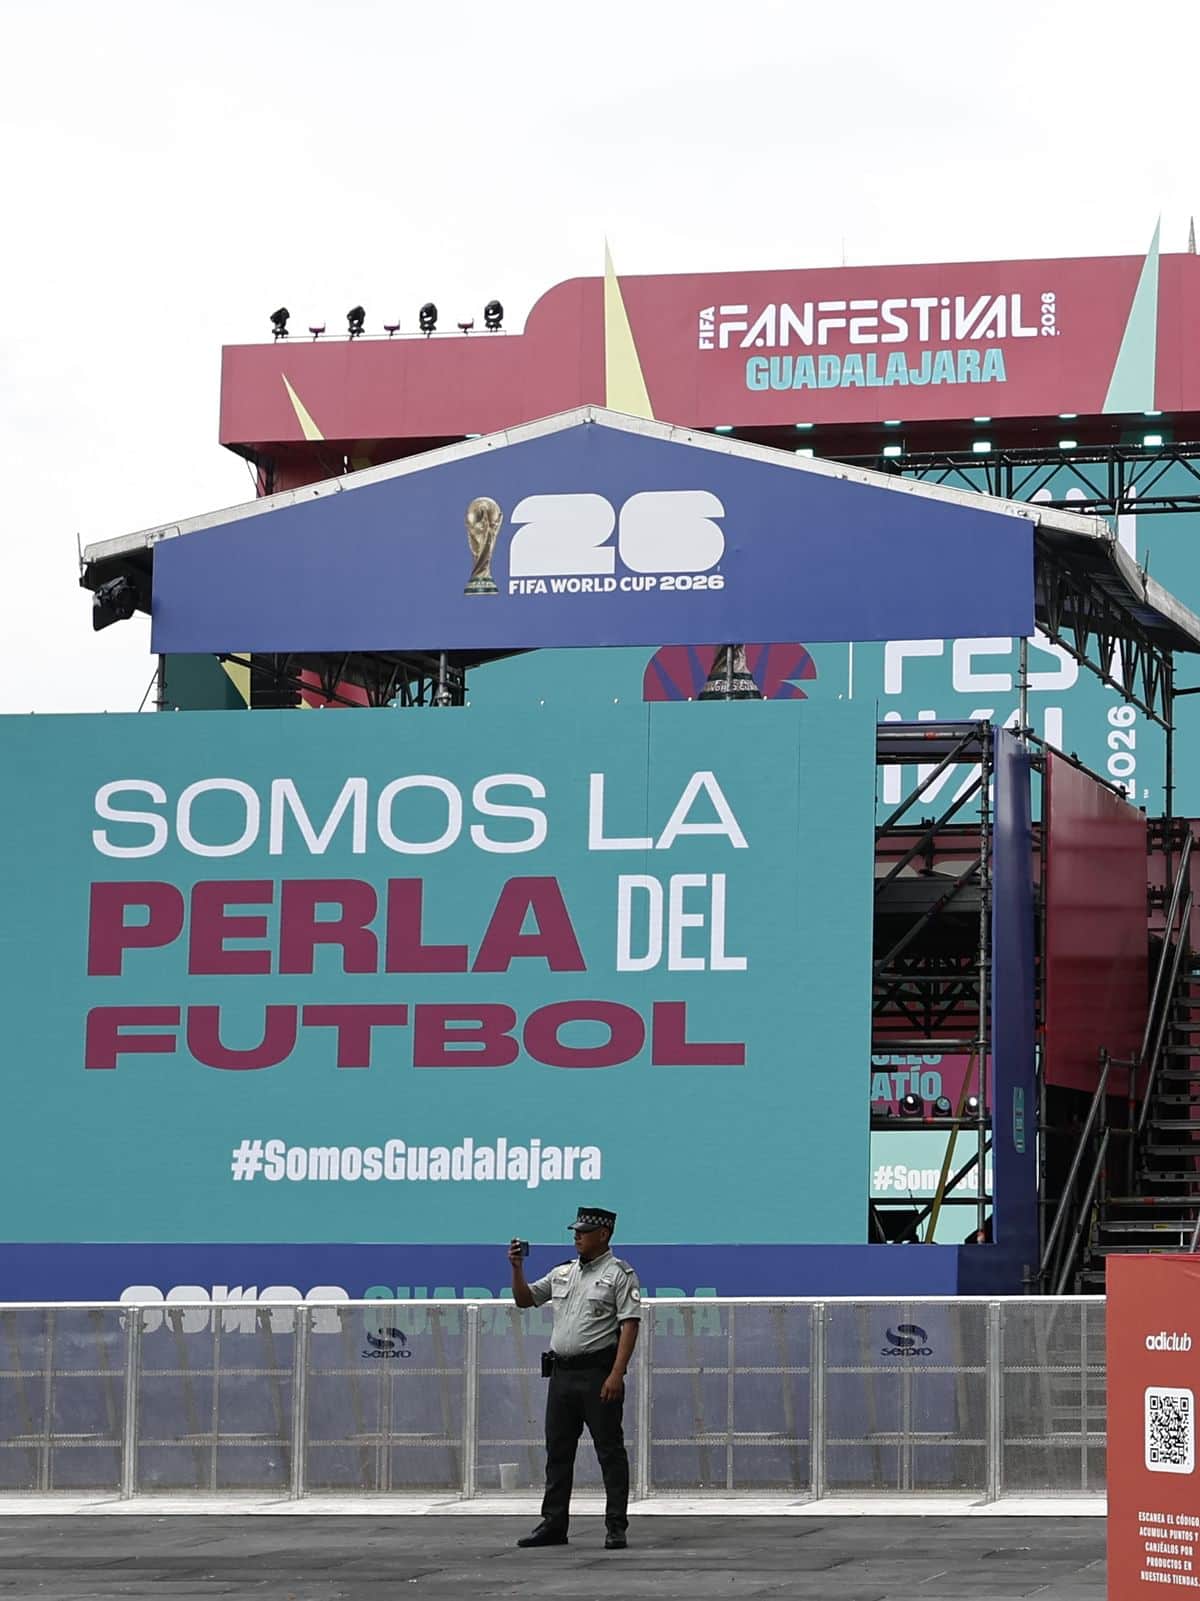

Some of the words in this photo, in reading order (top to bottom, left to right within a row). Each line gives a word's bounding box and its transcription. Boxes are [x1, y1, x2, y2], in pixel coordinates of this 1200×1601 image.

[699, 306, 716, 350] FIFA
[1041, 292, 1056, 336] 2026
[745, 348, 1007, 391] GUADALAJARA
[509, 490, 725, 576] 26
[509, 580, 547, 594] FIFA
[550, 577, 616, 593] WORLD
[620, 575, 656, 591] CUP
[659, 575, 725, 590] 2026
[92, 773, 548, 858] SOMOS
[588, 771, 749, 850] LA
[87, 876, 587, 976] PERLA
[617, 873, 748, 972] DEL
[84, 1000, 746, 1070] FUTBOL
[231, 1137, 601, 1188] #SomosGuadalajara
[1146, 1331, 1192, 1351] adiclub
[1138, 1511, 1165, 1524] ESCANEA
[1167, 1514, 1174, 1525] EL
[1139, 1526, 1168, 1538] ACUMULA
[1169, 1529, 1193, 1541] PUNTOS
[1146, 1556, 1182, 1570] PRODUCTOS
[1183, 1560, 1192, 1571] EN
[1180, 1545, 1193, 1556] POR
[1141, 1570, 1171, 1583] NUESTRAS
